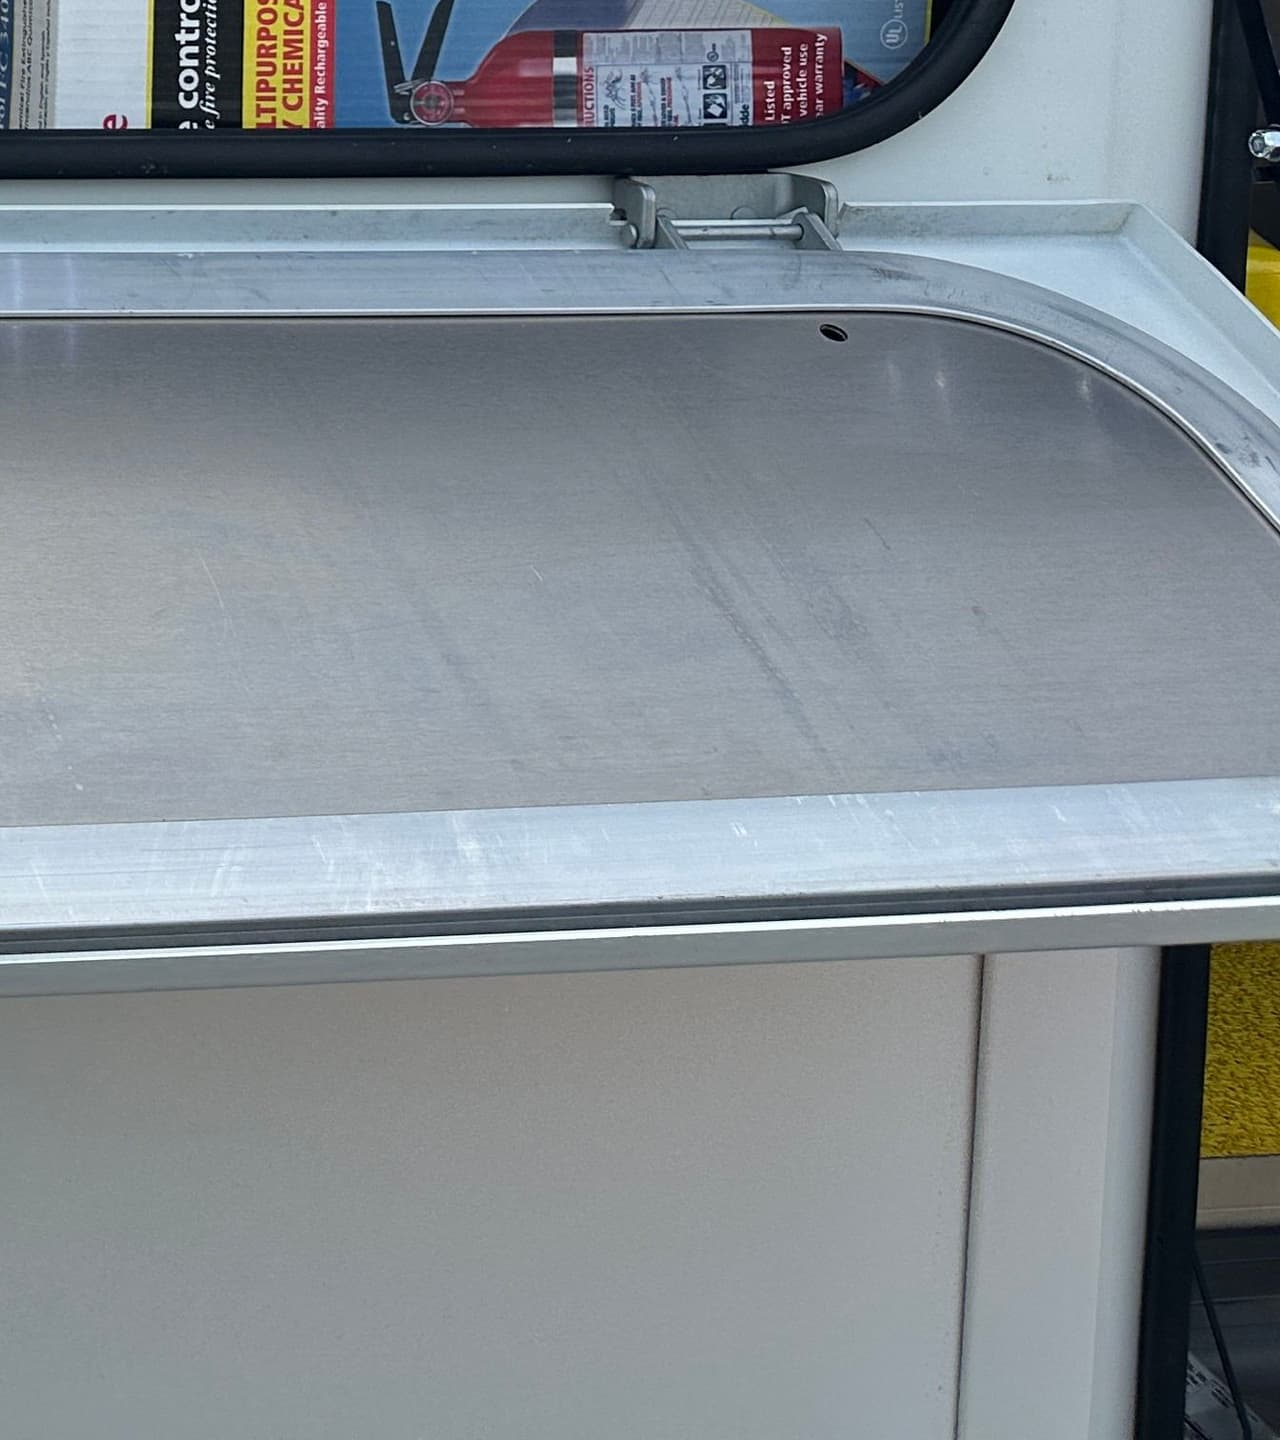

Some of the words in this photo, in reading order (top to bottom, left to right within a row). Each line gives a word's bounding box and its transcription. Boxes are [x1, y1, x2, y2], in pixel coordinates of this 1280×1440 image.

[313, 2, 330, 94] Rechargeable
[799, 43, 809, 66] use
[815, 33, 828, 95] warranty
[583, 66, 595, 126] UCTIONS
[781, 46, 795, 110] approved
[796, 69, 808, 117] vehicle
[199, 81, 221, 120] fire
[313, 99, 329, 129] ality
[739, 104, 750, 126] dde
[763, 80, 776, 121] Listed
